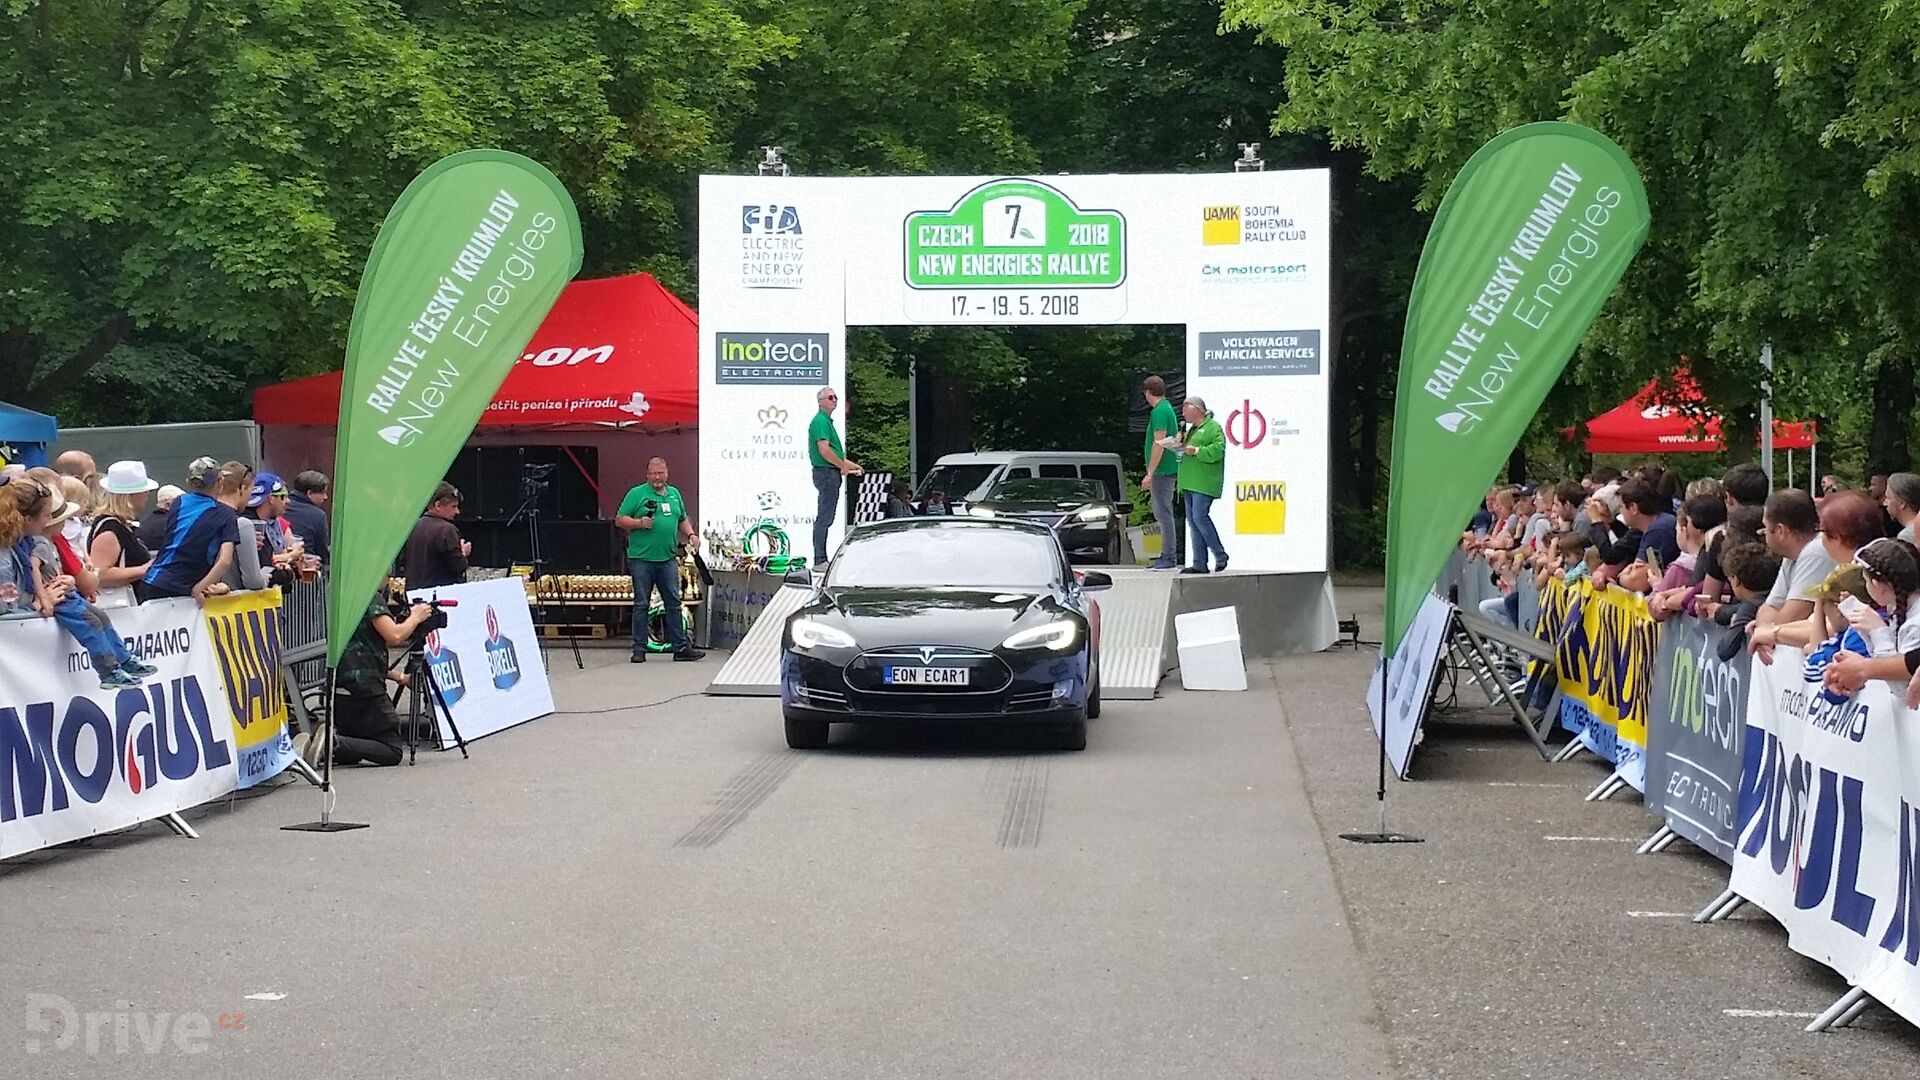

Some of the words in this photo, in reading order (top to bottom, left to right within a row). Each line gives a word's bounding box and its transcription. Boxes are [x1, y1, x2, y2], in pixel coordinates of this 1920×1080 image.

[1203, 207, 1240, 221] UAMK
[1245, 206, 1279, 216] SOUTH
[1005, 205, 1021, 239] 7
[1245, 219, 1294, 229] BOHEMIA
[742, 238, 803, 249] ELECTRIC
[918, 225, 973, 247] CZECH
[1068, 224, 1109, 246] 2018
[1245, 232, 1276, 242] RALLY
[1279, 230, 1306, 241] CLUB
[743, 252, 770, 261] AND
[773, 252, 803, 261] NEW
[918, 254, 956, 276] NEW
[961, 253, 1042, 276] ENERGIES
[1047, 253, 1110, 275] RALLYE
[742, 263, 803, 275] ENERGY
[1227, 264, 1307, 275] motorsport
[1424, 322, 1486, 400] RALLYE
[1467, 256, 1524, 326] ČESKÝ
[1510, 163, 1582, 262] KRUMLOV
[366, 339, 427, 414] RALLYE
[408, 276, 464, 344] ČESKÝ
[451, 189, 519, 282] KRUMLOV
[952, 296, 970, 316] 17.
[993, 295, 1012, 316] 19.
[1019, 295, 1034, 316] 5.
[1041, 295, 1079, 315] 2018
[1456, 342, 1520, 421] New
[1512, 186, 1620, 330] Energies
[397, 358, 460, 435] New
[452, 212, 555, 348] Energies
[722, 338, 823, 362] inotech
[1222, 336, 1298, 348] VOLKSWAGEN
[1204, 350, 1262, 360] FINANCIAL
[1265, 348, 1315, 359] SERVICES
[1236, 484, 1285, 502] UAMK
[892, 668, 917, 682] EON
[924, 669, 965, 683] ECAR1
[0, 674, 231, 823] MOGUL
